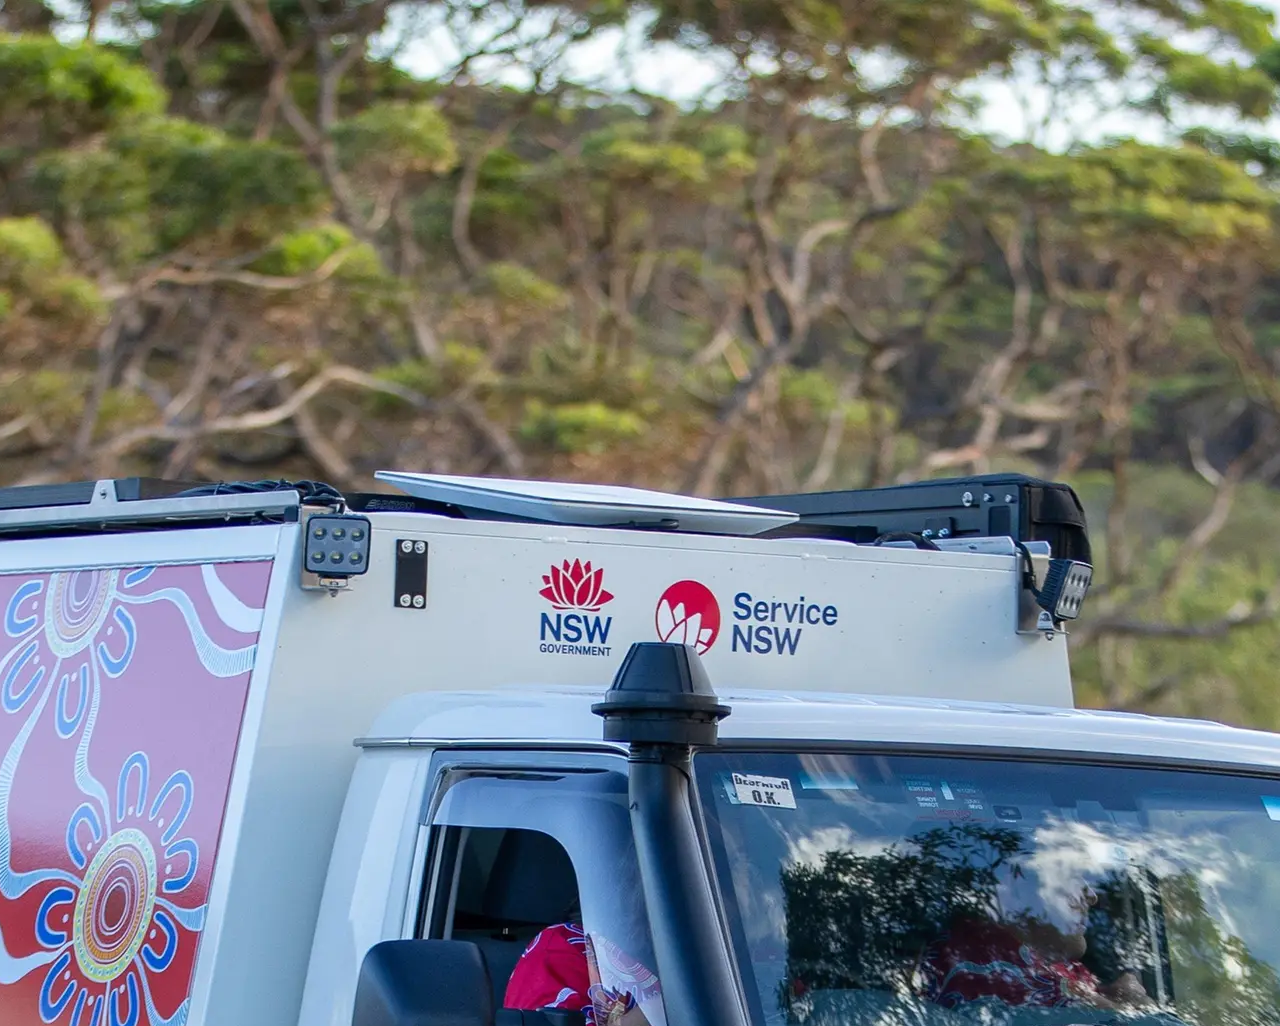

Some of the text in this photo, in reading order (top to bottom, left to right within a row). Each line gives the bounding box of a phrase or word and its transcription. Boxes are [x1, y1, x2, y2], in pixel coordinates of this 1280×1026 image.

[733, 592, 838, 626] Service
[540, 612, 612, 644] NSW
[731, 624, 802, 656] NSW
[539, 643, 612, 657] GOVERNMENT
